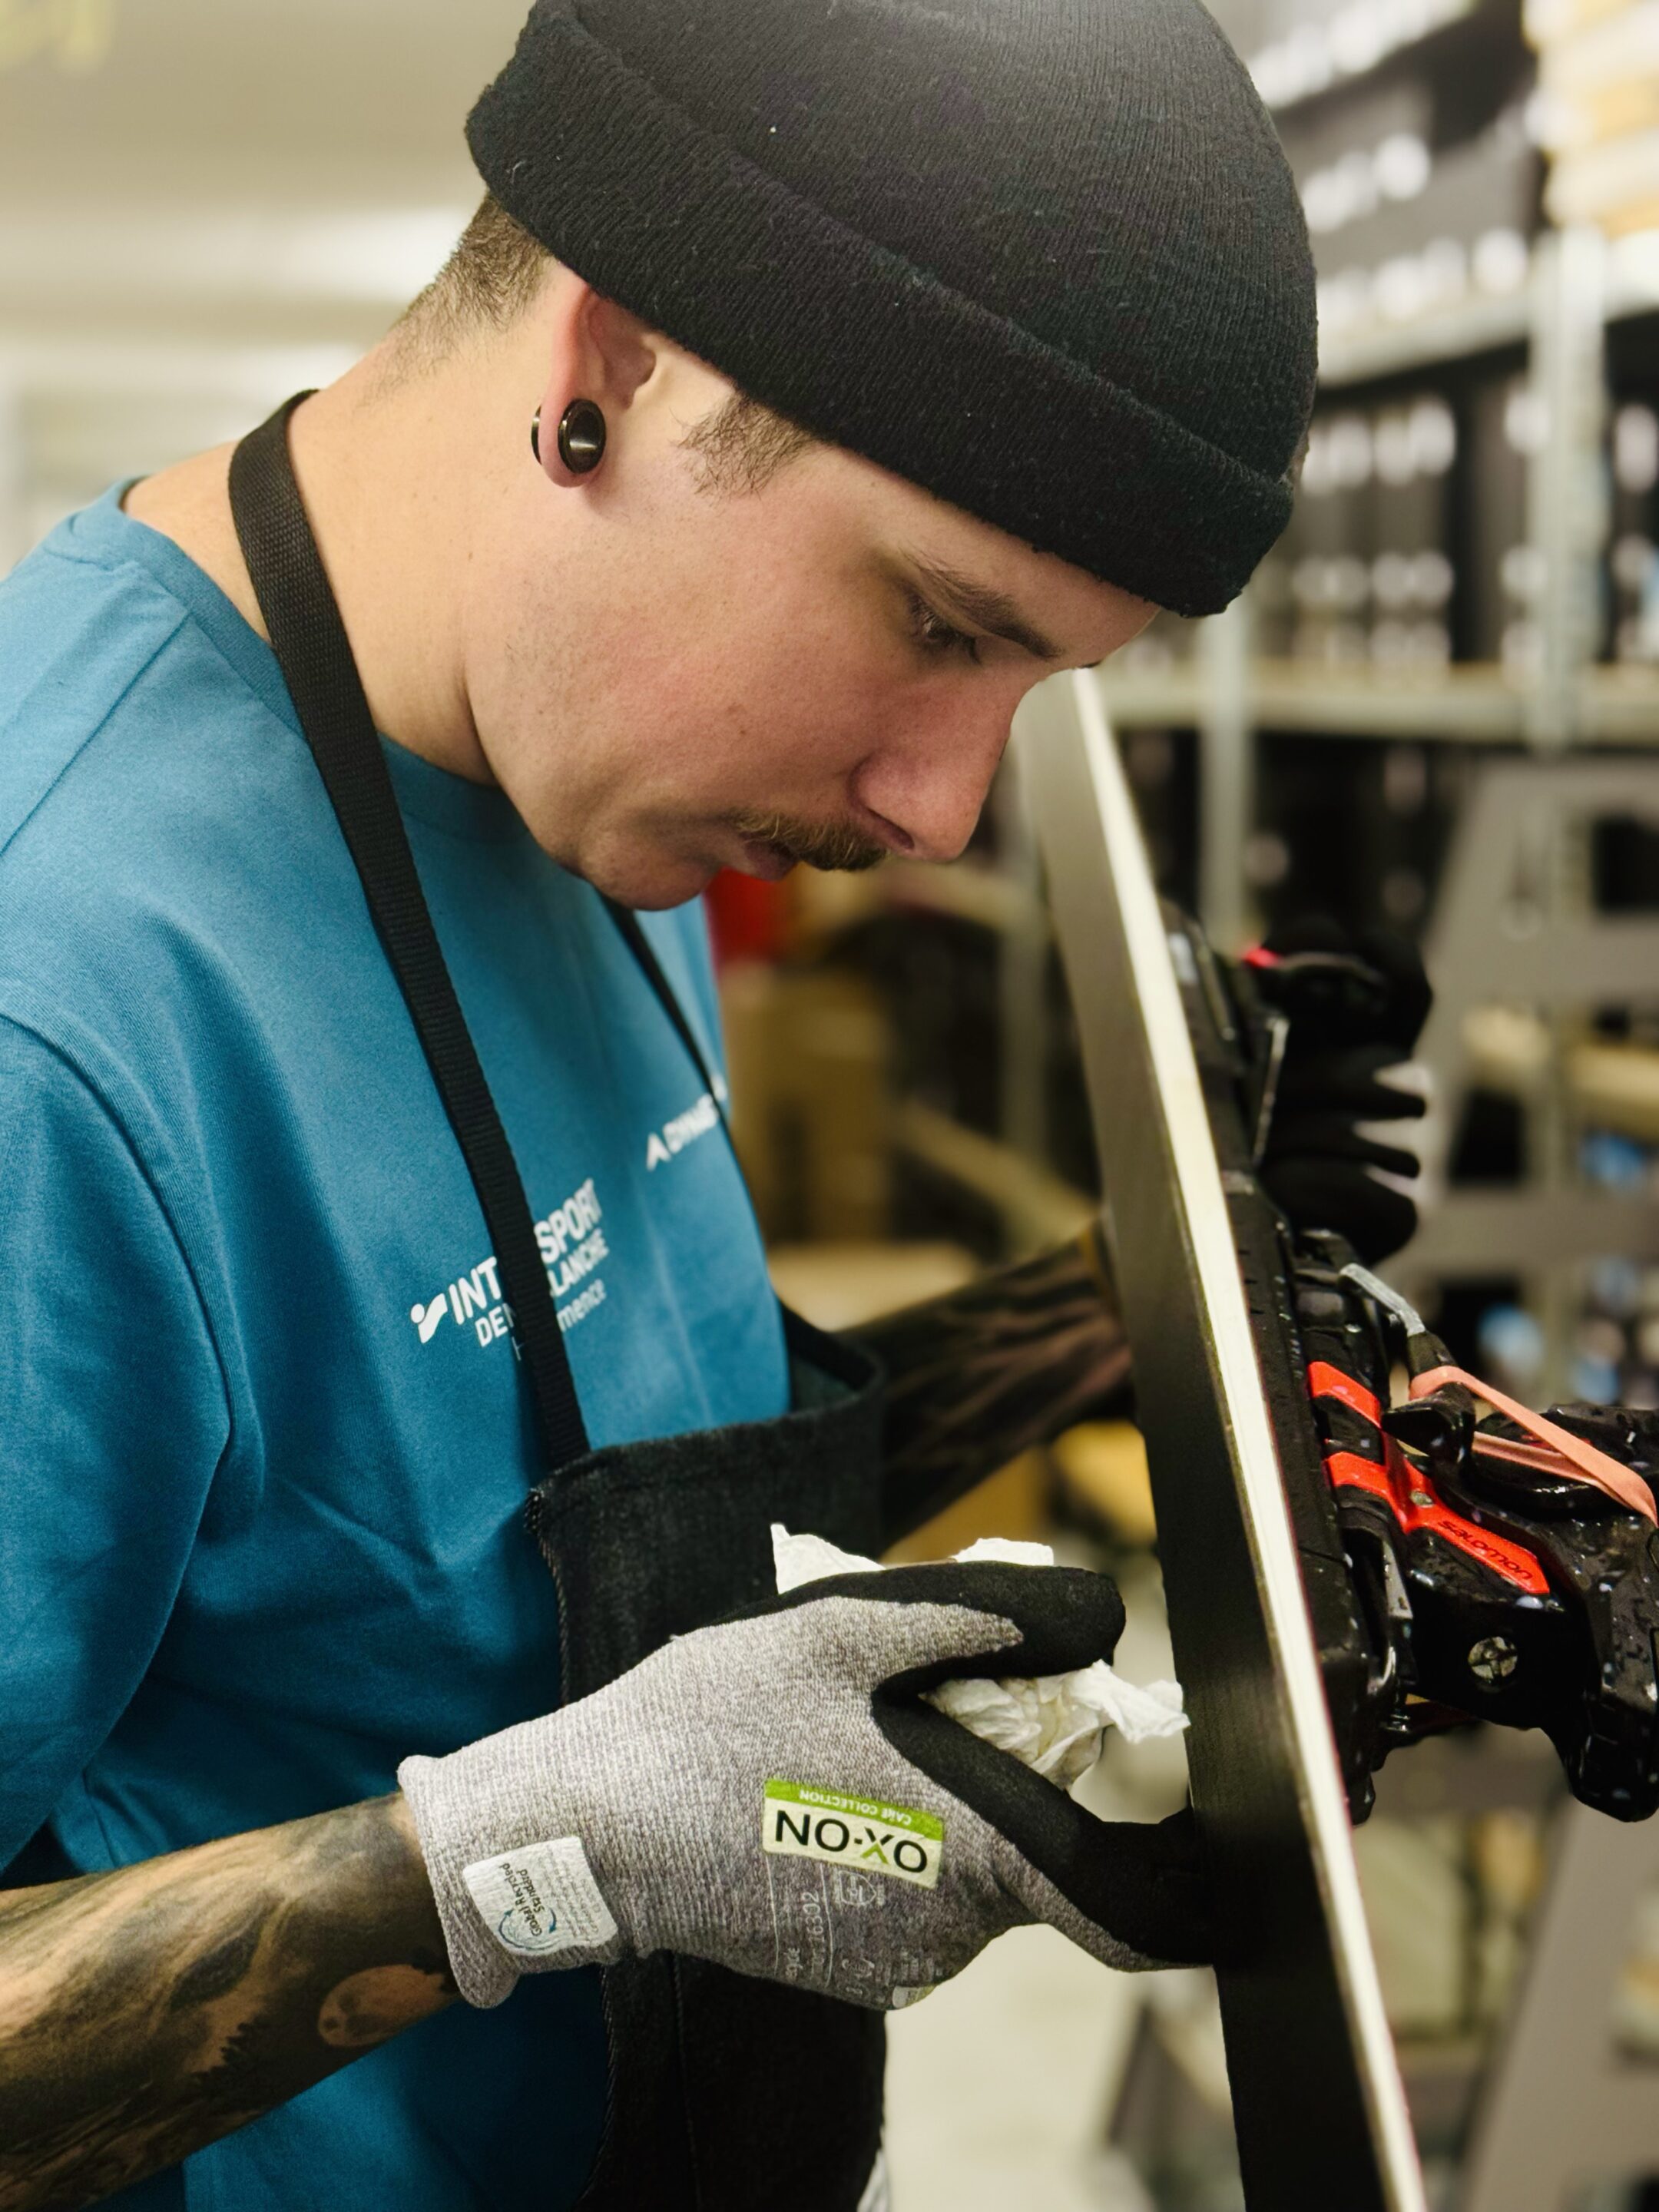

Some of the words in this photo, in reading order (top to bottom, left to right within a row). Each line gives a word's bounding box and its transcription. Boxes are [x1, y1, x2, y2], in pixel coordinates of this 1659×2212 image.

[449, 1177, 602, 1325] INTSPORT
[547, 1227, 609, 1298] LANCHE
[799, 1789, 878, 1816] COLLECTION
[775, 1809, 928, 1873] OX-ON
[500, 1862, 527, 1906] Recycled
[515, 1868, 545, 1914] Standard
[518, 1906, 542, 1937] Global
